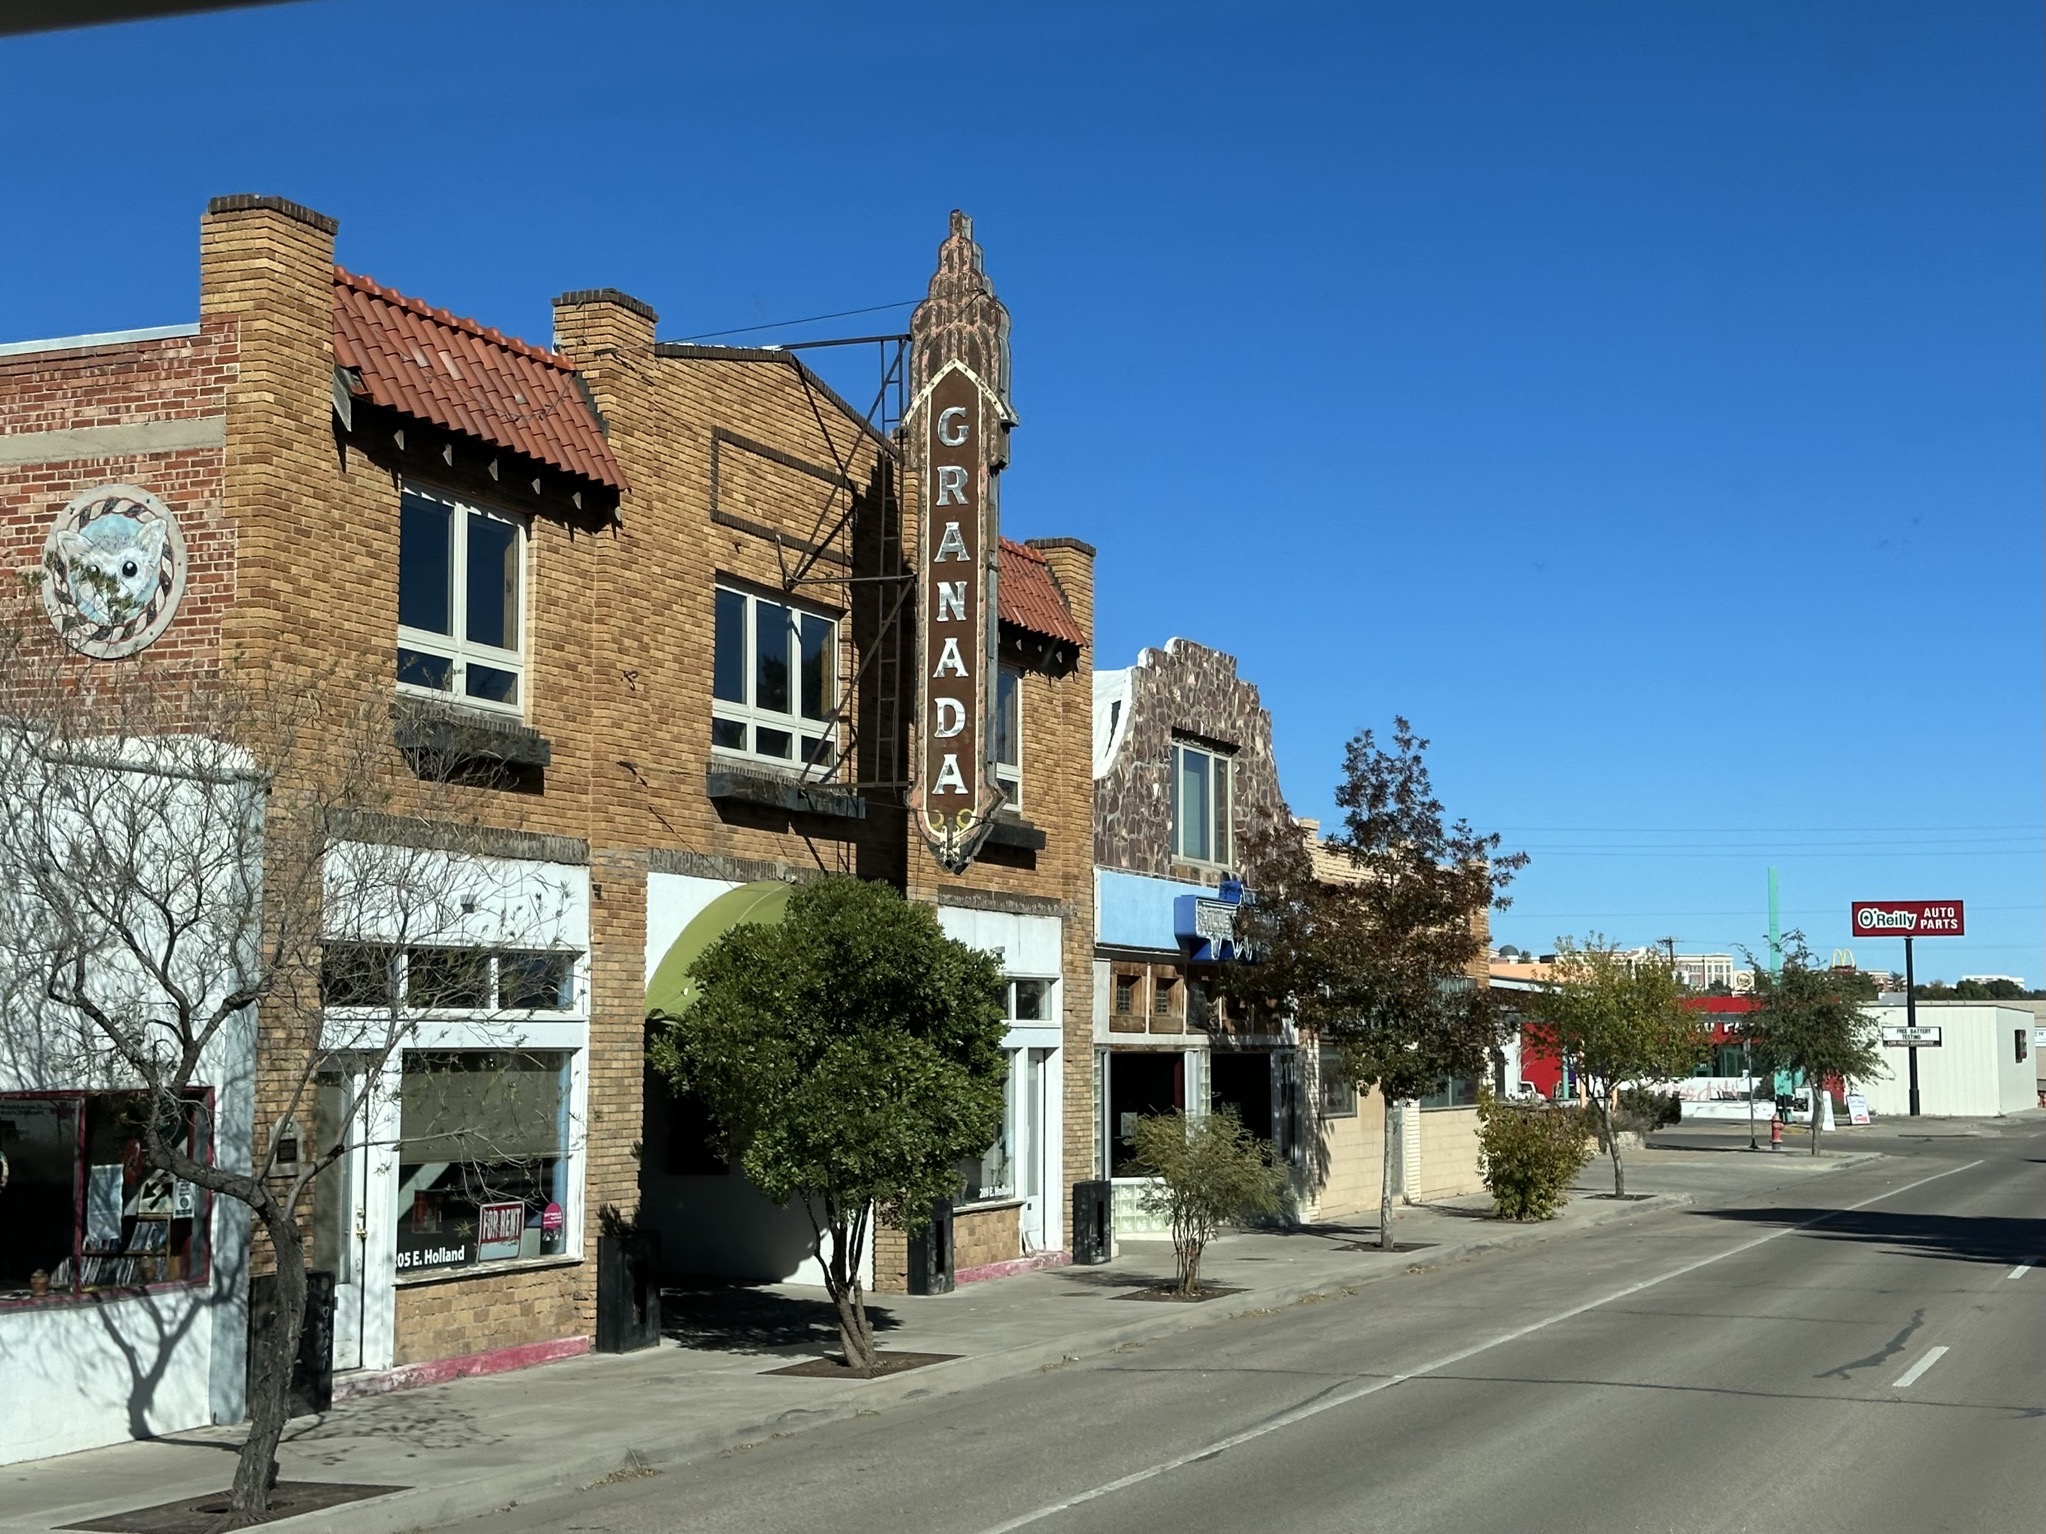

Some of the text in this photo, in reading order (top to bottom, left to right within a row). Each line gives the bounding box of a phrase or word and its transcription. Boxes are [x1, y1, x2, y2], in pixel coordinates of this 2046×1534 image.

[932, 405, 971, 796] GRANADA
[1858, 908, 1917, 930] O'Reilly
[1923, 907, 1955, 918] AUTO
[1920, 919, 1958, 930] PARTS
[482, 1209, 498, 1240] FOR
[500, 1207, 522, 1238] RENT
[396, 1244, 465, 1268] 05 E. Holland
